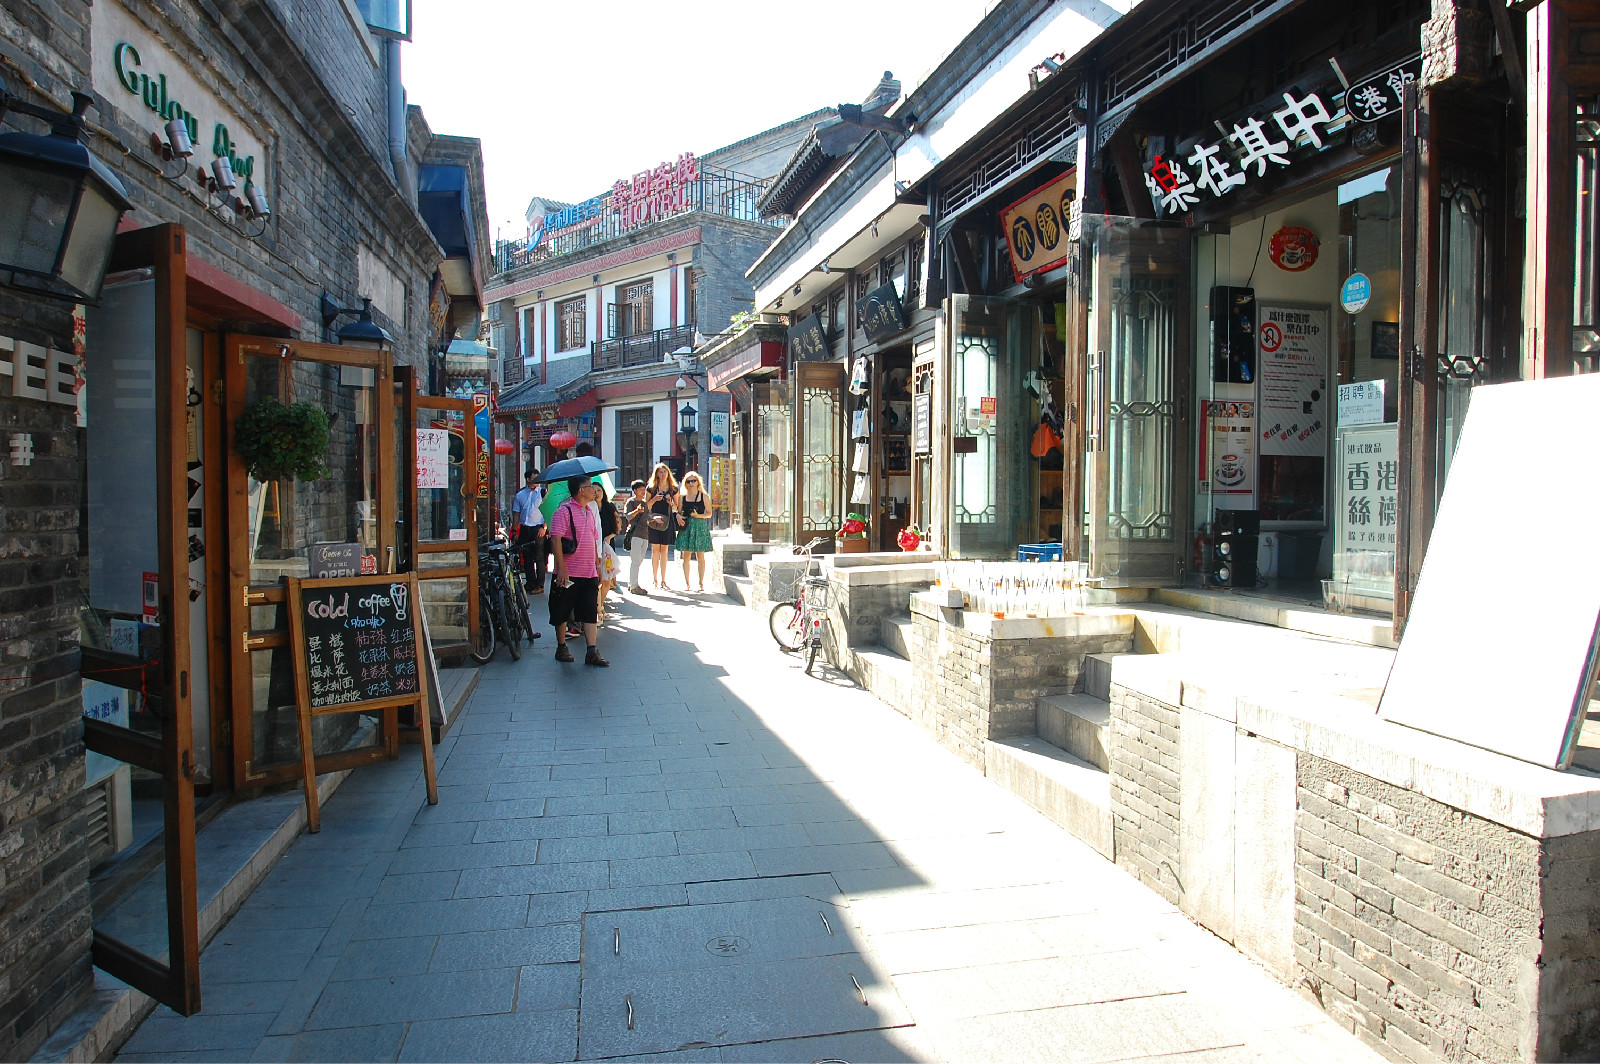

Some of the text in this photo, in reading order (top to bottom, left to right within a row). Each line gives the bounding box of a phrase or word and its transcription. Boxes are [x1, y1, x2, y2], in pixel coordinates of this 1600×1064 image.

[1144, 92, 1332, 214] 樂在其中
[621, 186, 689, 229] HOTEL
[1339, 384, 1364, 402] 招聘
[358, 593, 391, 615] coffee
[365, 679, 393, 696] 奶茶
